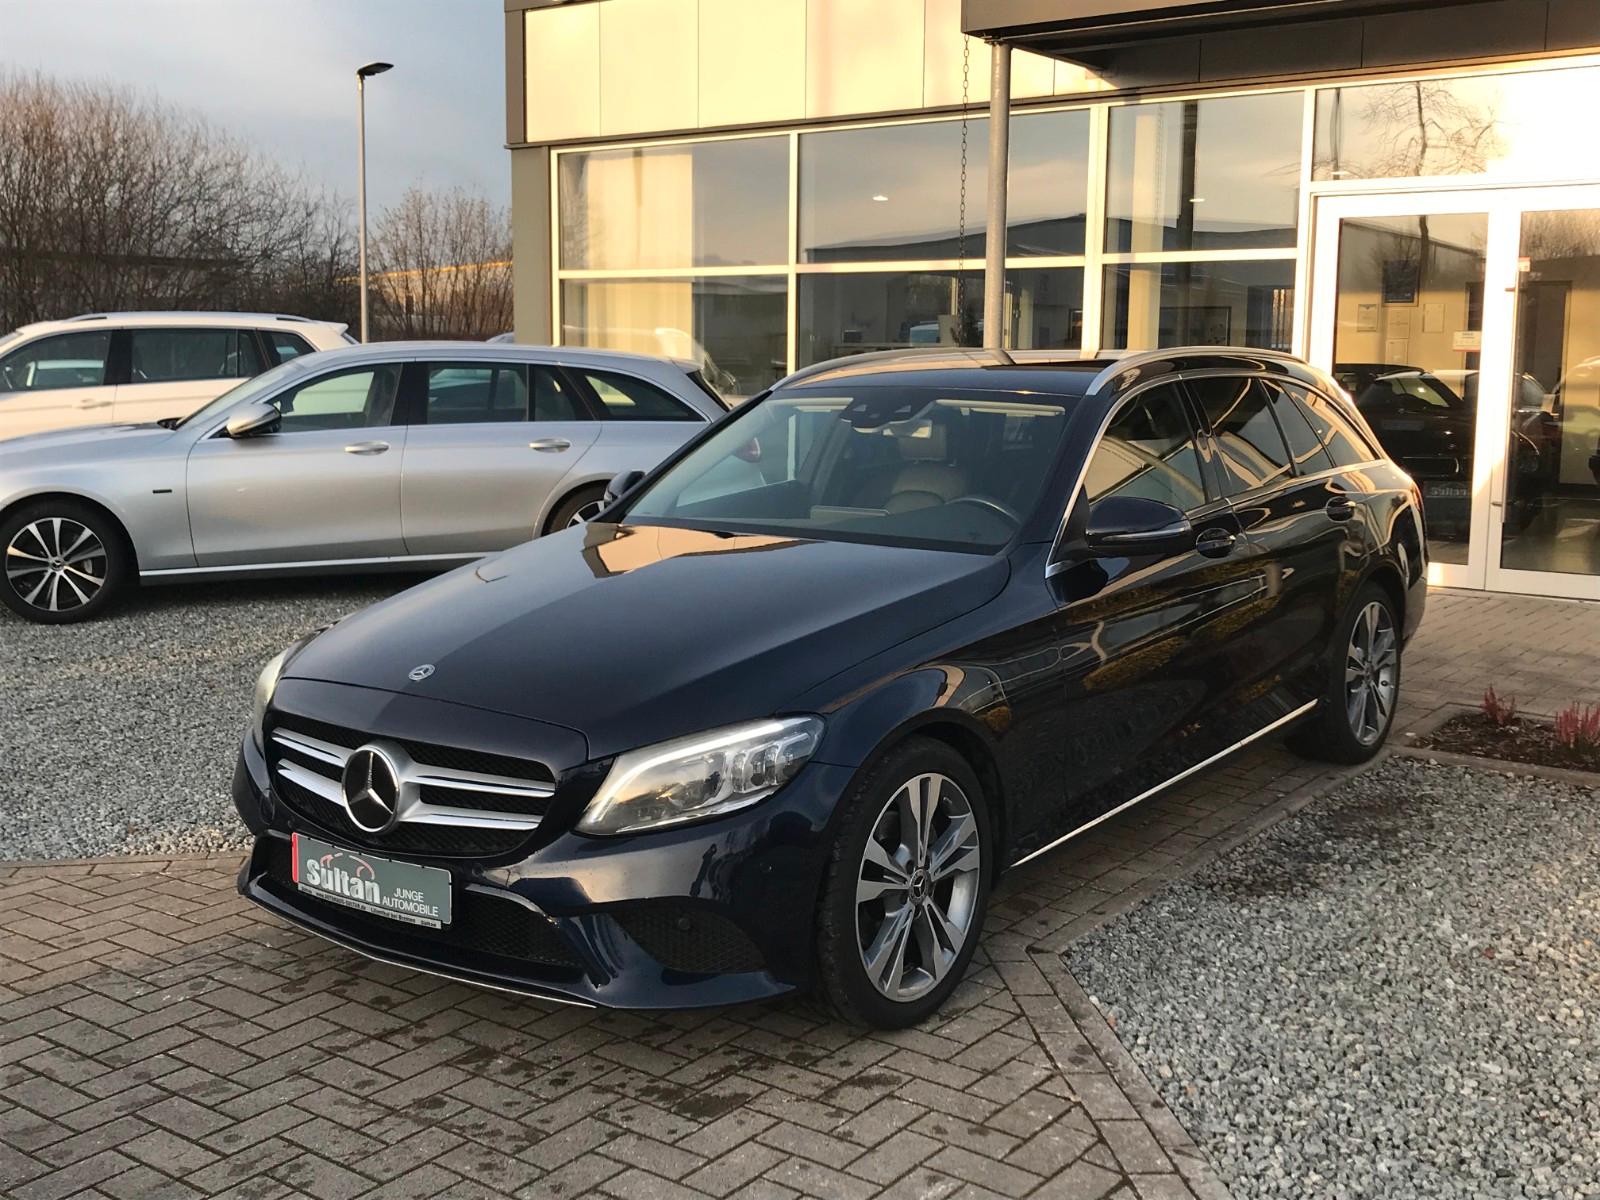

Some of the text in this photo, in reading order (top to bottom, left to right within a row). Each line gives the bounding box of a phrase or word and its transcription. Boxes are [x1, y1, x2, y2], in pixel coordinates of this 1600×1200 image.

[306, 858, 381, 905] Sultan
[382, 895, 439, 917] AUTOMOBILE
[393, 887, 425, 903] JUNGE
